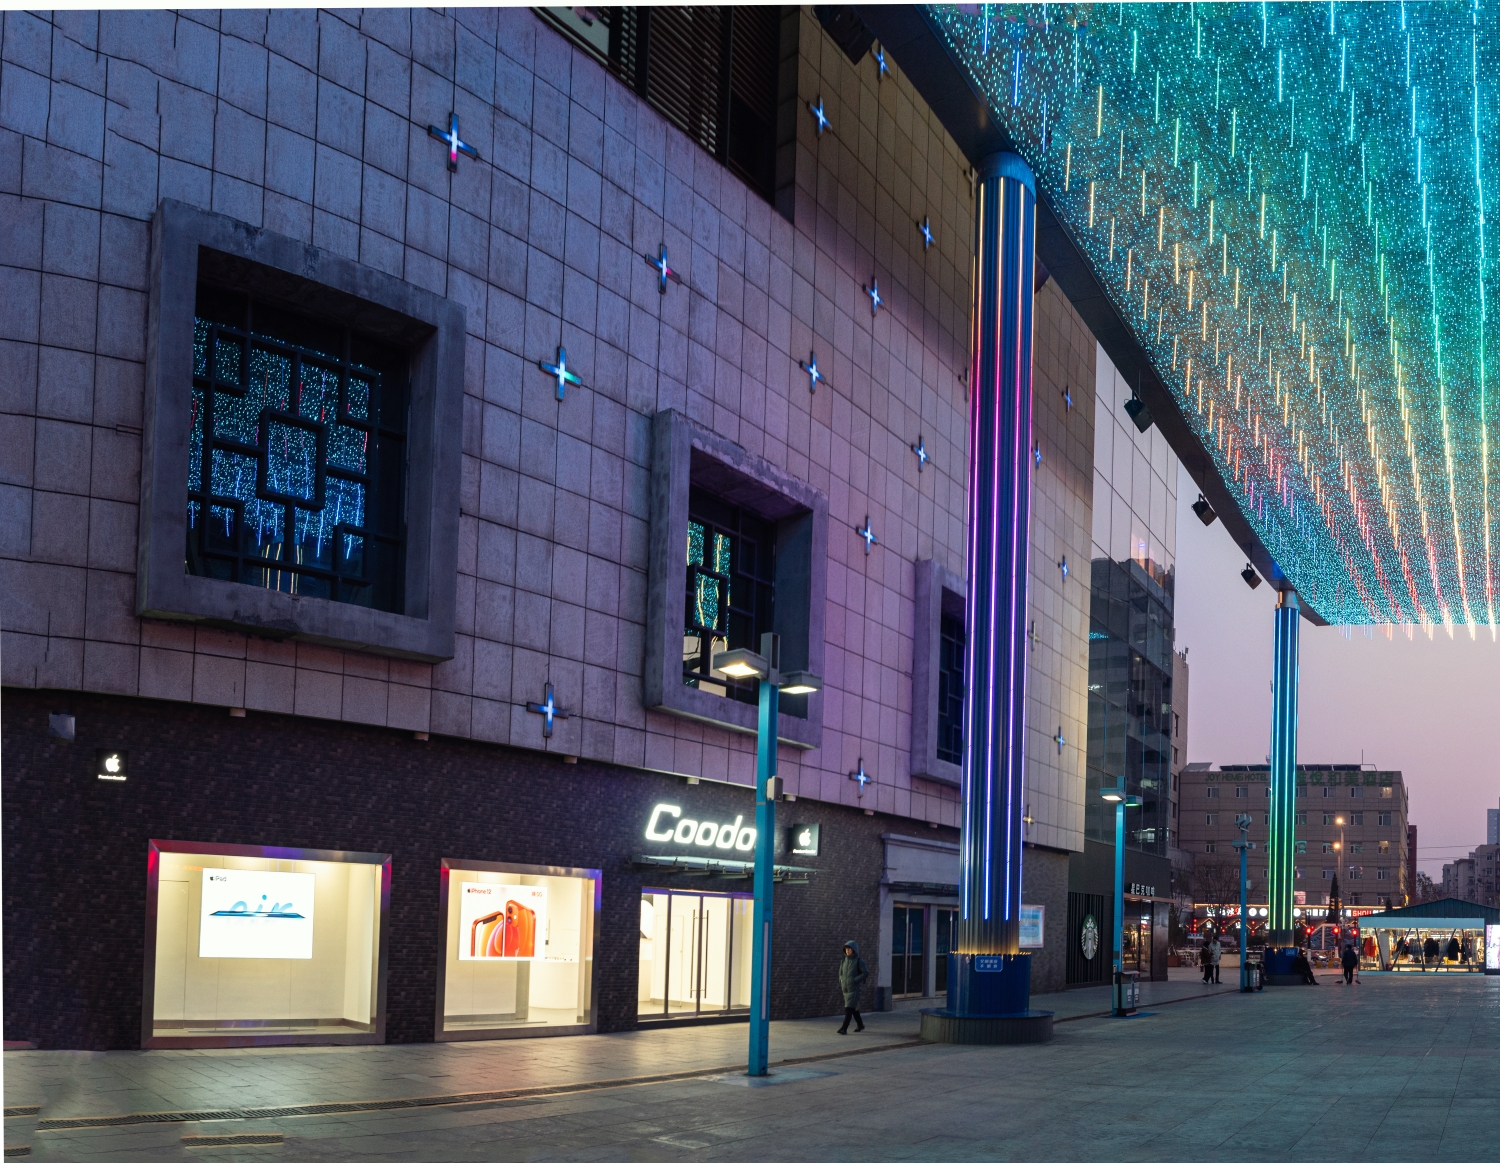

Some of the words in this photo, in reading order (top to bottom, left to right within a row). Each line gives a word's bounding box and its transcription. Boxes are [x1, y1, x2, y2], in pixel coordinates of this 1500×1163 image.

[1206, 773, 1221, 782] JOY
[1245, 772, 1269, 781] HOTEL
[645, 803, 757, 851] Coodo
